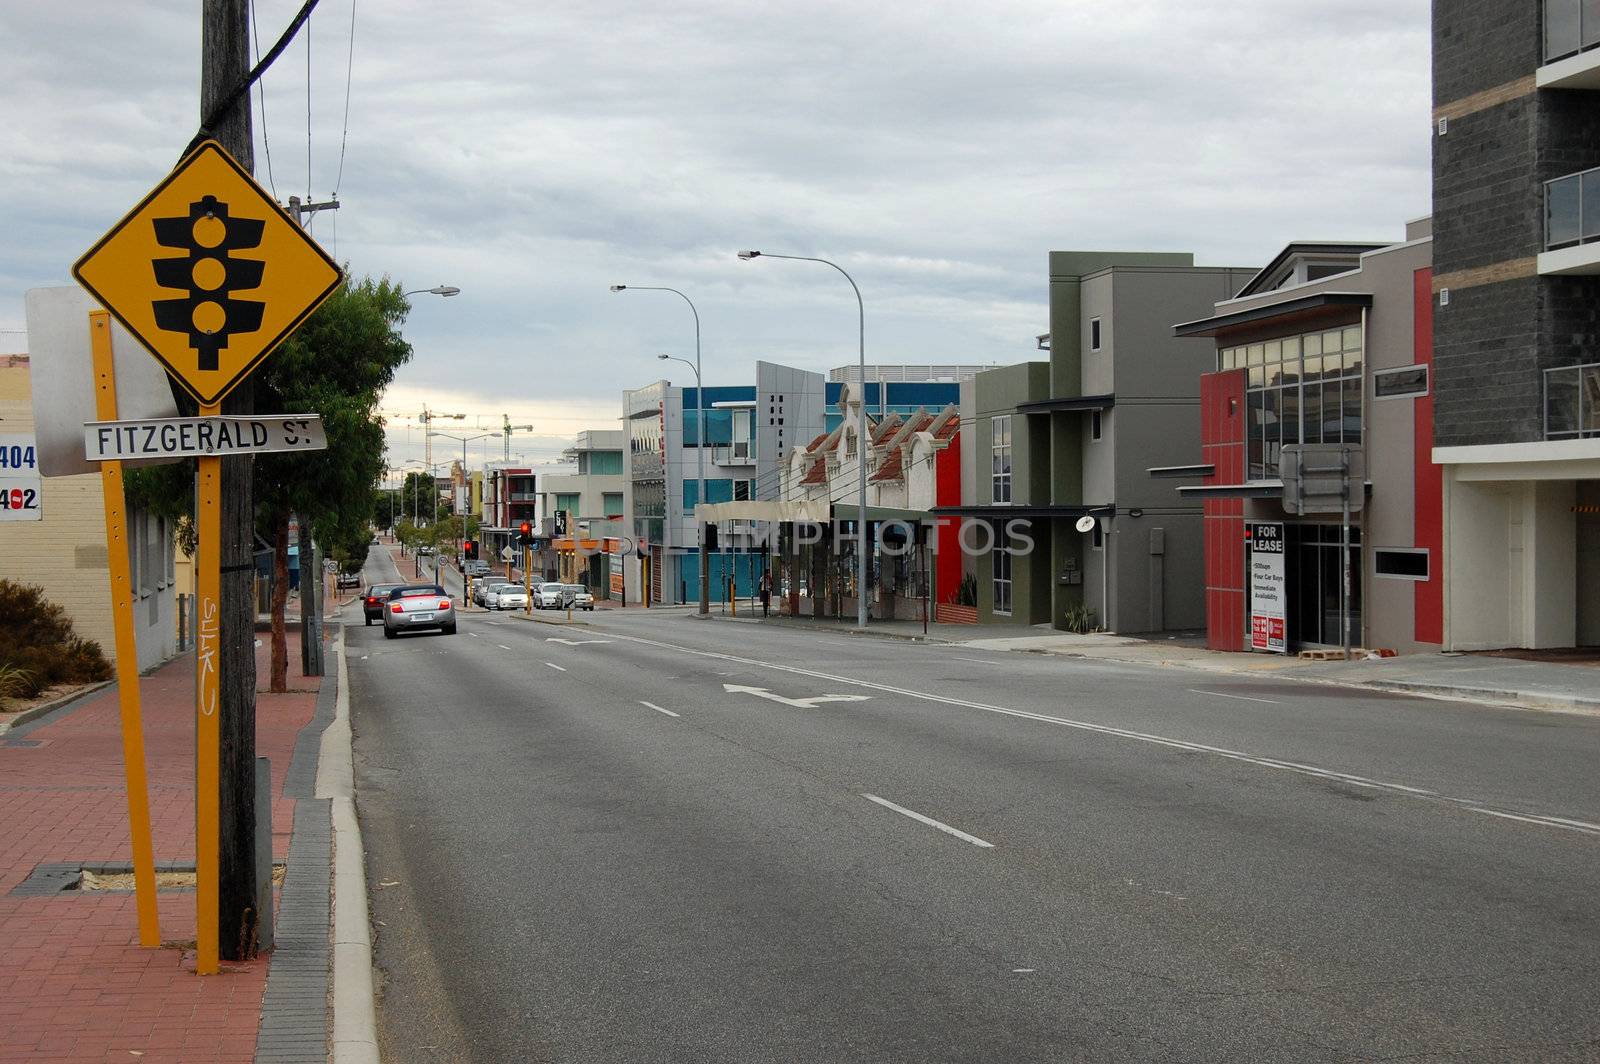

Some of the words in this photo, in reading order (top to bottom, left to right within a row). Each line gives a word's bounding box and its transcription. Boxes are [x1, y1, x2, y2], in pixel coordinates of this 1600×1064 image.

[98, 421, 268, 454] FITZGERALD
[0, 446, 35, 468] 404
[1258, 526, 1277, 537] FOR
[1253, 539, 1282, 551] LEASE
